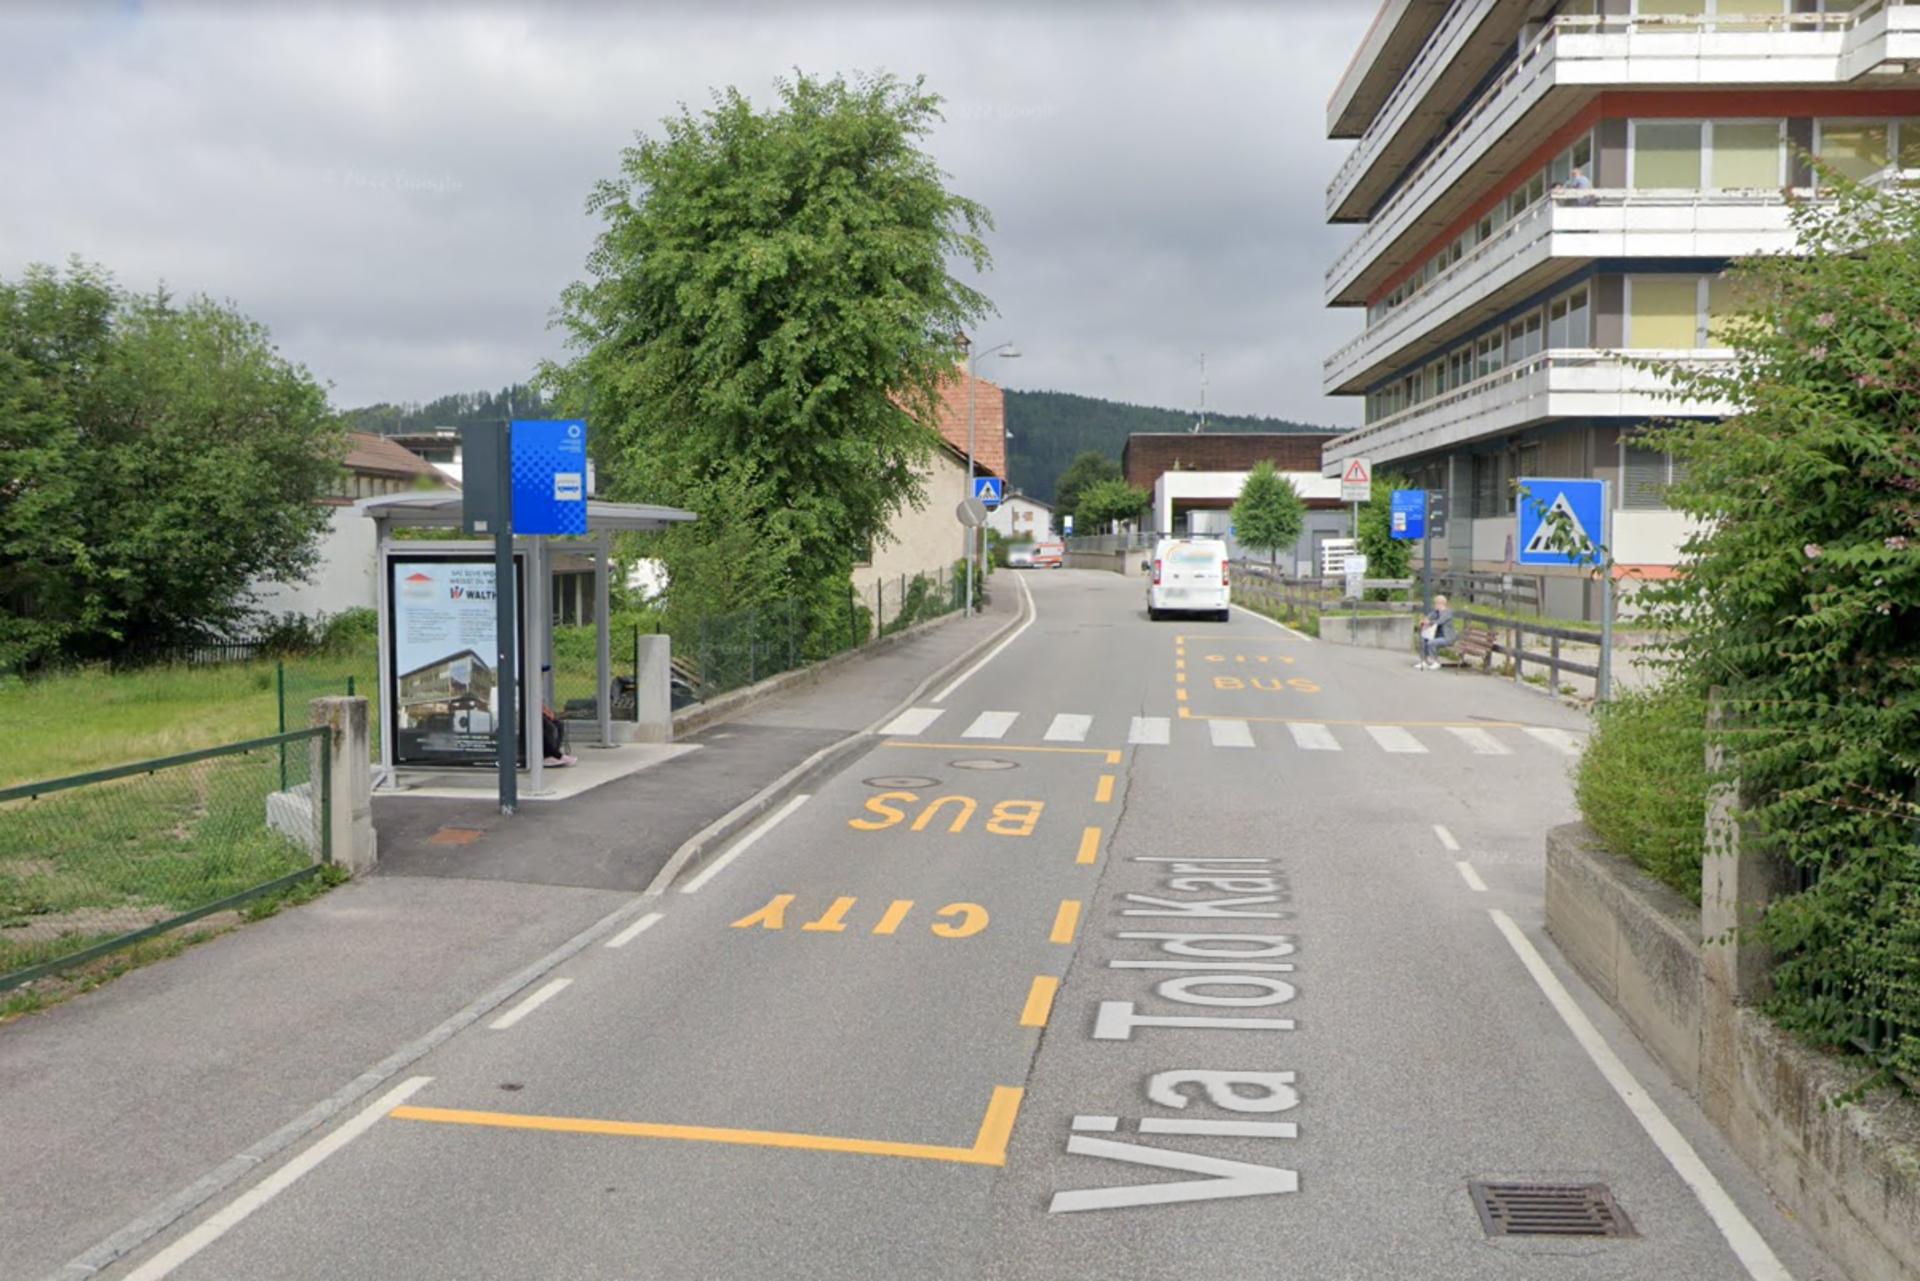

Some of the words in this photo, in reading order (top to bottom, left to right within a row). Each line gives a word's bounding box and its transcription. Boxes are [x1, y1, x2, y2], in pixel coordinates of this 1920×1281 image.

[1213, 676, 1322, 693] BUS
[848, 791, 1045, 836] BUS
[729, 894, 989, 938] CITY
